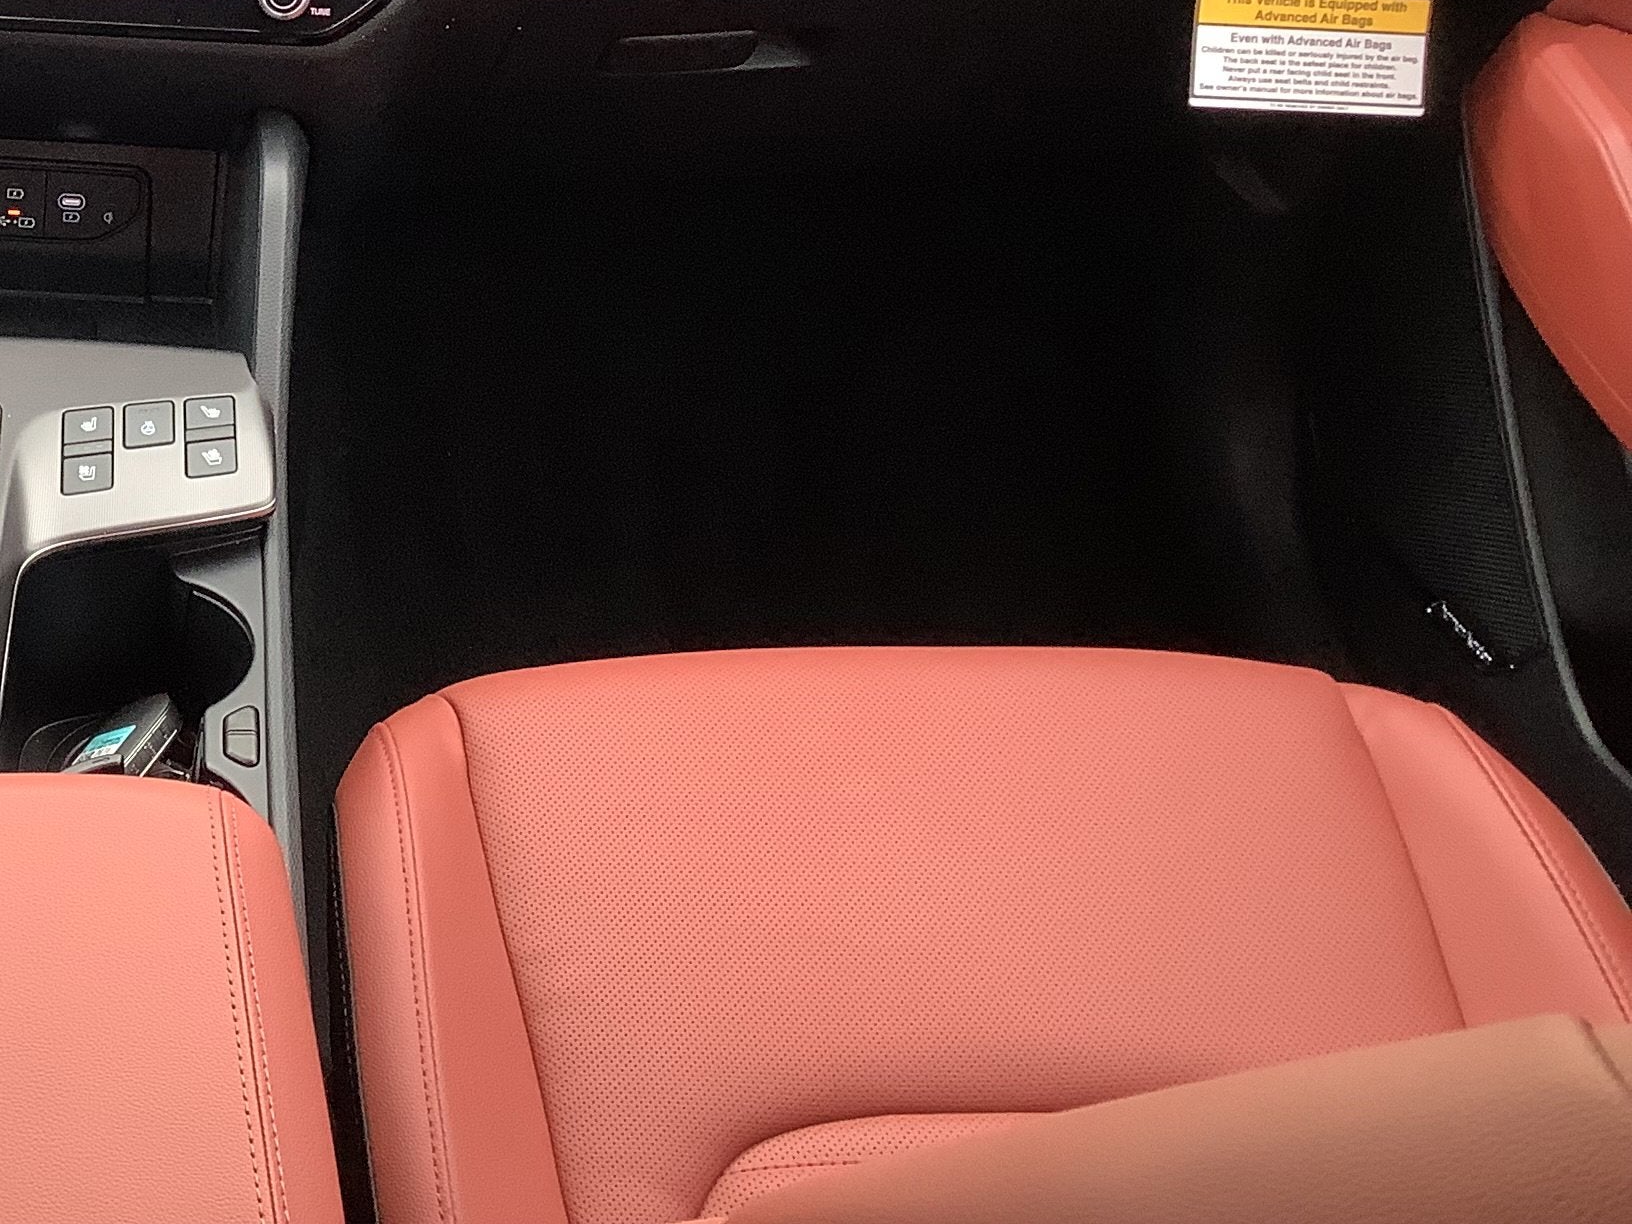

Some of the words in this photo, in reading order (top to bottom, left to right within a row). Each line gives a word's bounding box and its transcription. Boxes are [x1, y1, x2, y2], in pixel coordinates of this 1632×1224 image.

[1382, 2, 1408, 13] with
[1255, 10, 1317, 23] Advanced
[1320, 14, 1339, 25] Air
[1342, 15, 1373, 28] Bags
[1230, 32, 1258, 43] Even
[1262, 35, 1284, 45] with
[1287, 35, 1342, 48] Advanced
[1345, 38, 1361, 49] Air
[1364, 39, 1392, 52] Bags
